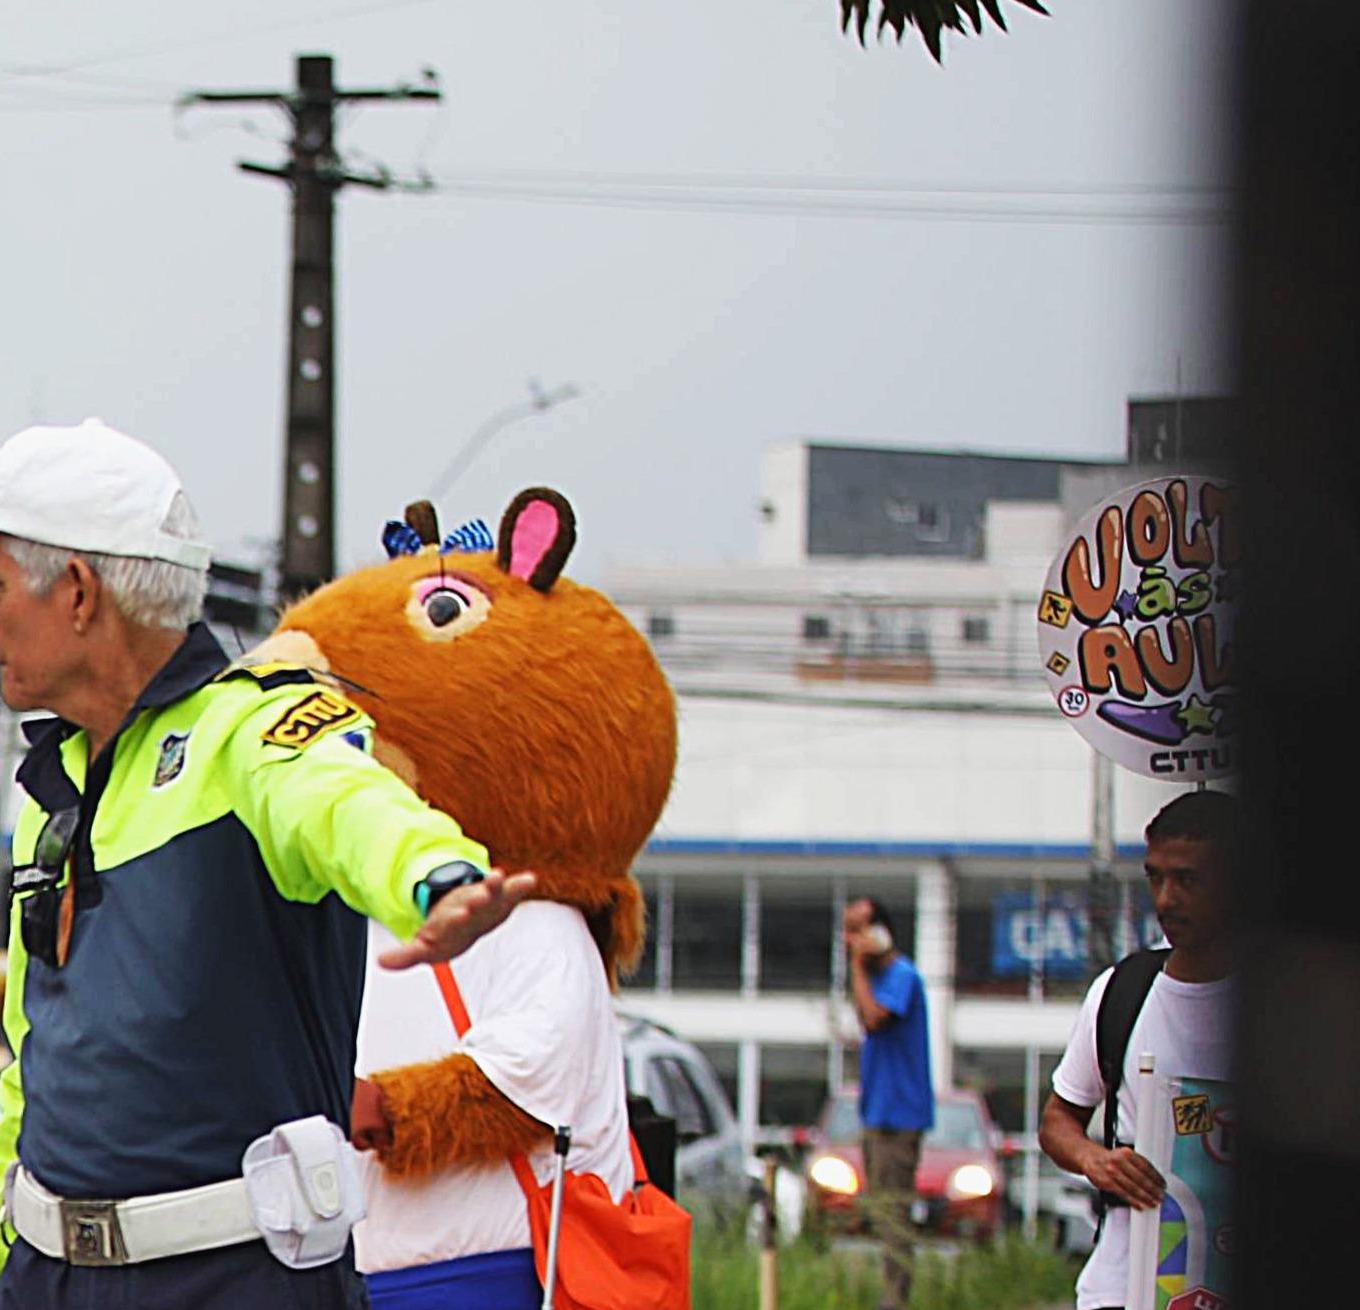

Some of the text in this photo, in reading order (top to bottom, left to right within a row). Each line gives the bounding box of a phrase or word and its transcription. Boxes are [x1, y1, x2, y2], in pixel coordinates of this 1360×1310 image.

[1061, 479, 1237, 627] VOLT
[1077, 614, 1233, 701] AUL
[273, 693, 349, 743] CTTU
